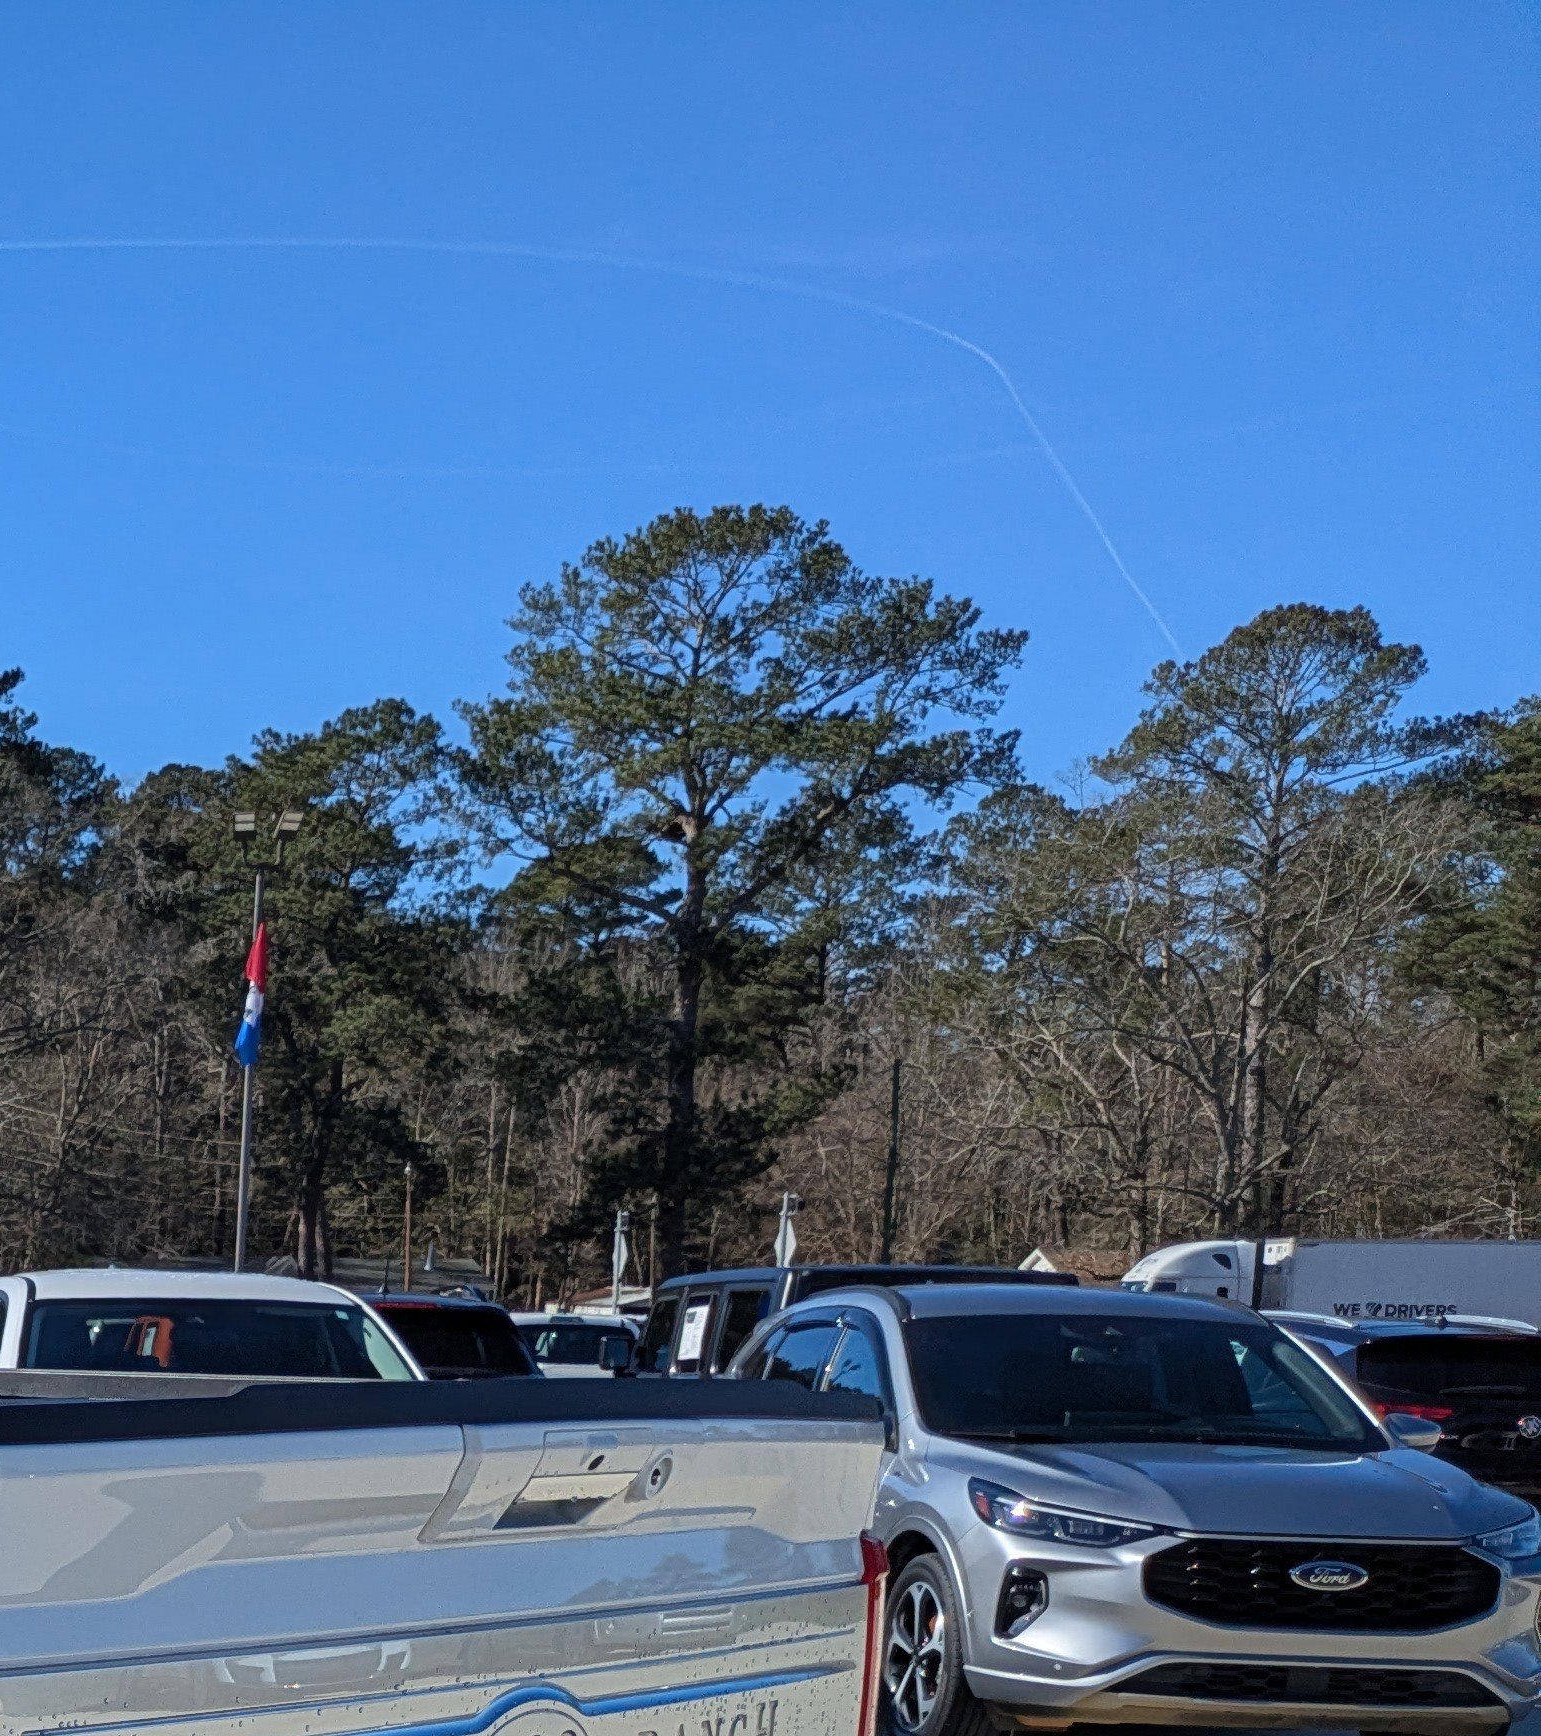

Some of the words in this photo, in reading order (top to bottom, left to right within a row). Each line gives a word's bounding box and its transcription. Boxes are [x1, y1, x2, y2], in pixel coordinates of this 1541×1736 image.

[1333, 1303, 1361, 1316] WE
[1384, 1304, 1457, 1318] DRIVERS
[1309, 1566, 1352, 1584] Ford
